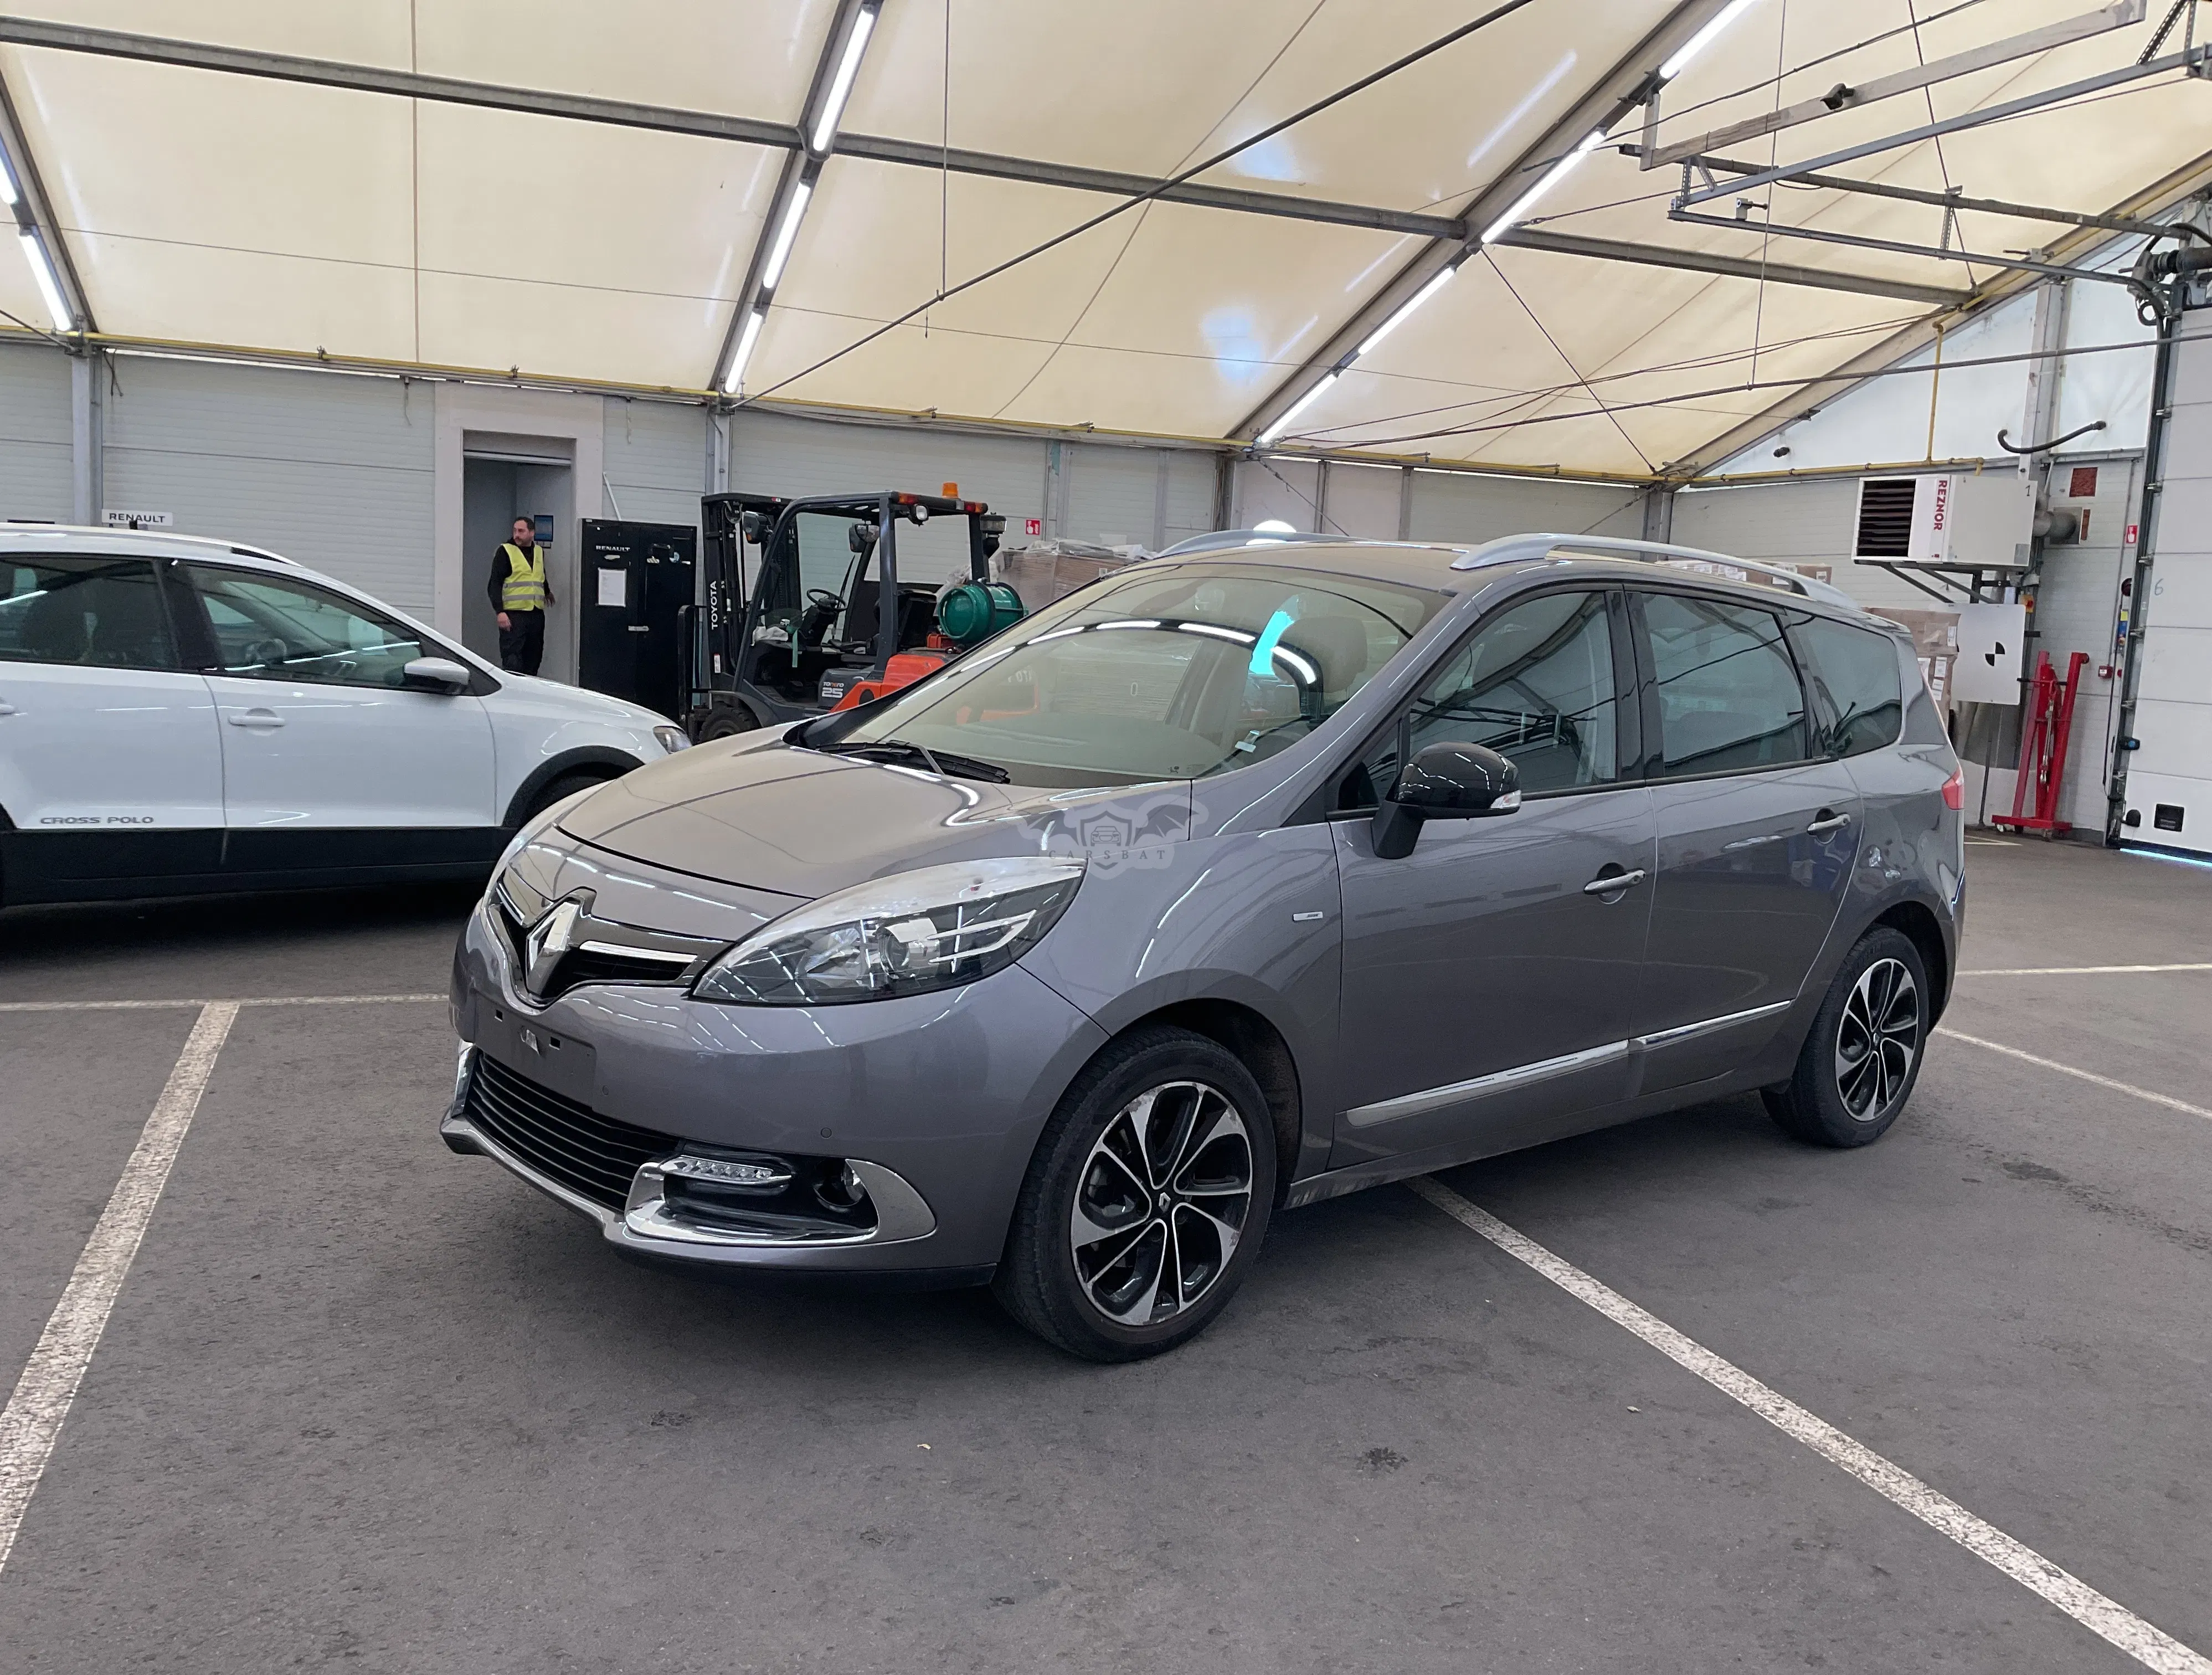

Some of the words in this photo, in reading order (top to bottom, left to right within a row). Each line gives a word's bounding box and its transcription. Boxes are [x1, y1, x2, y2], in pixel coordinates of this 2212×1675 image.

[2025, 485, 2030, 496] 1
[1933, 480, 1947, 531] REZNOR
[109, 513, 165, 523] RENAULT
[710, 580, 718, 630] TOYOTA
[822, 687, 843, 698] 25
